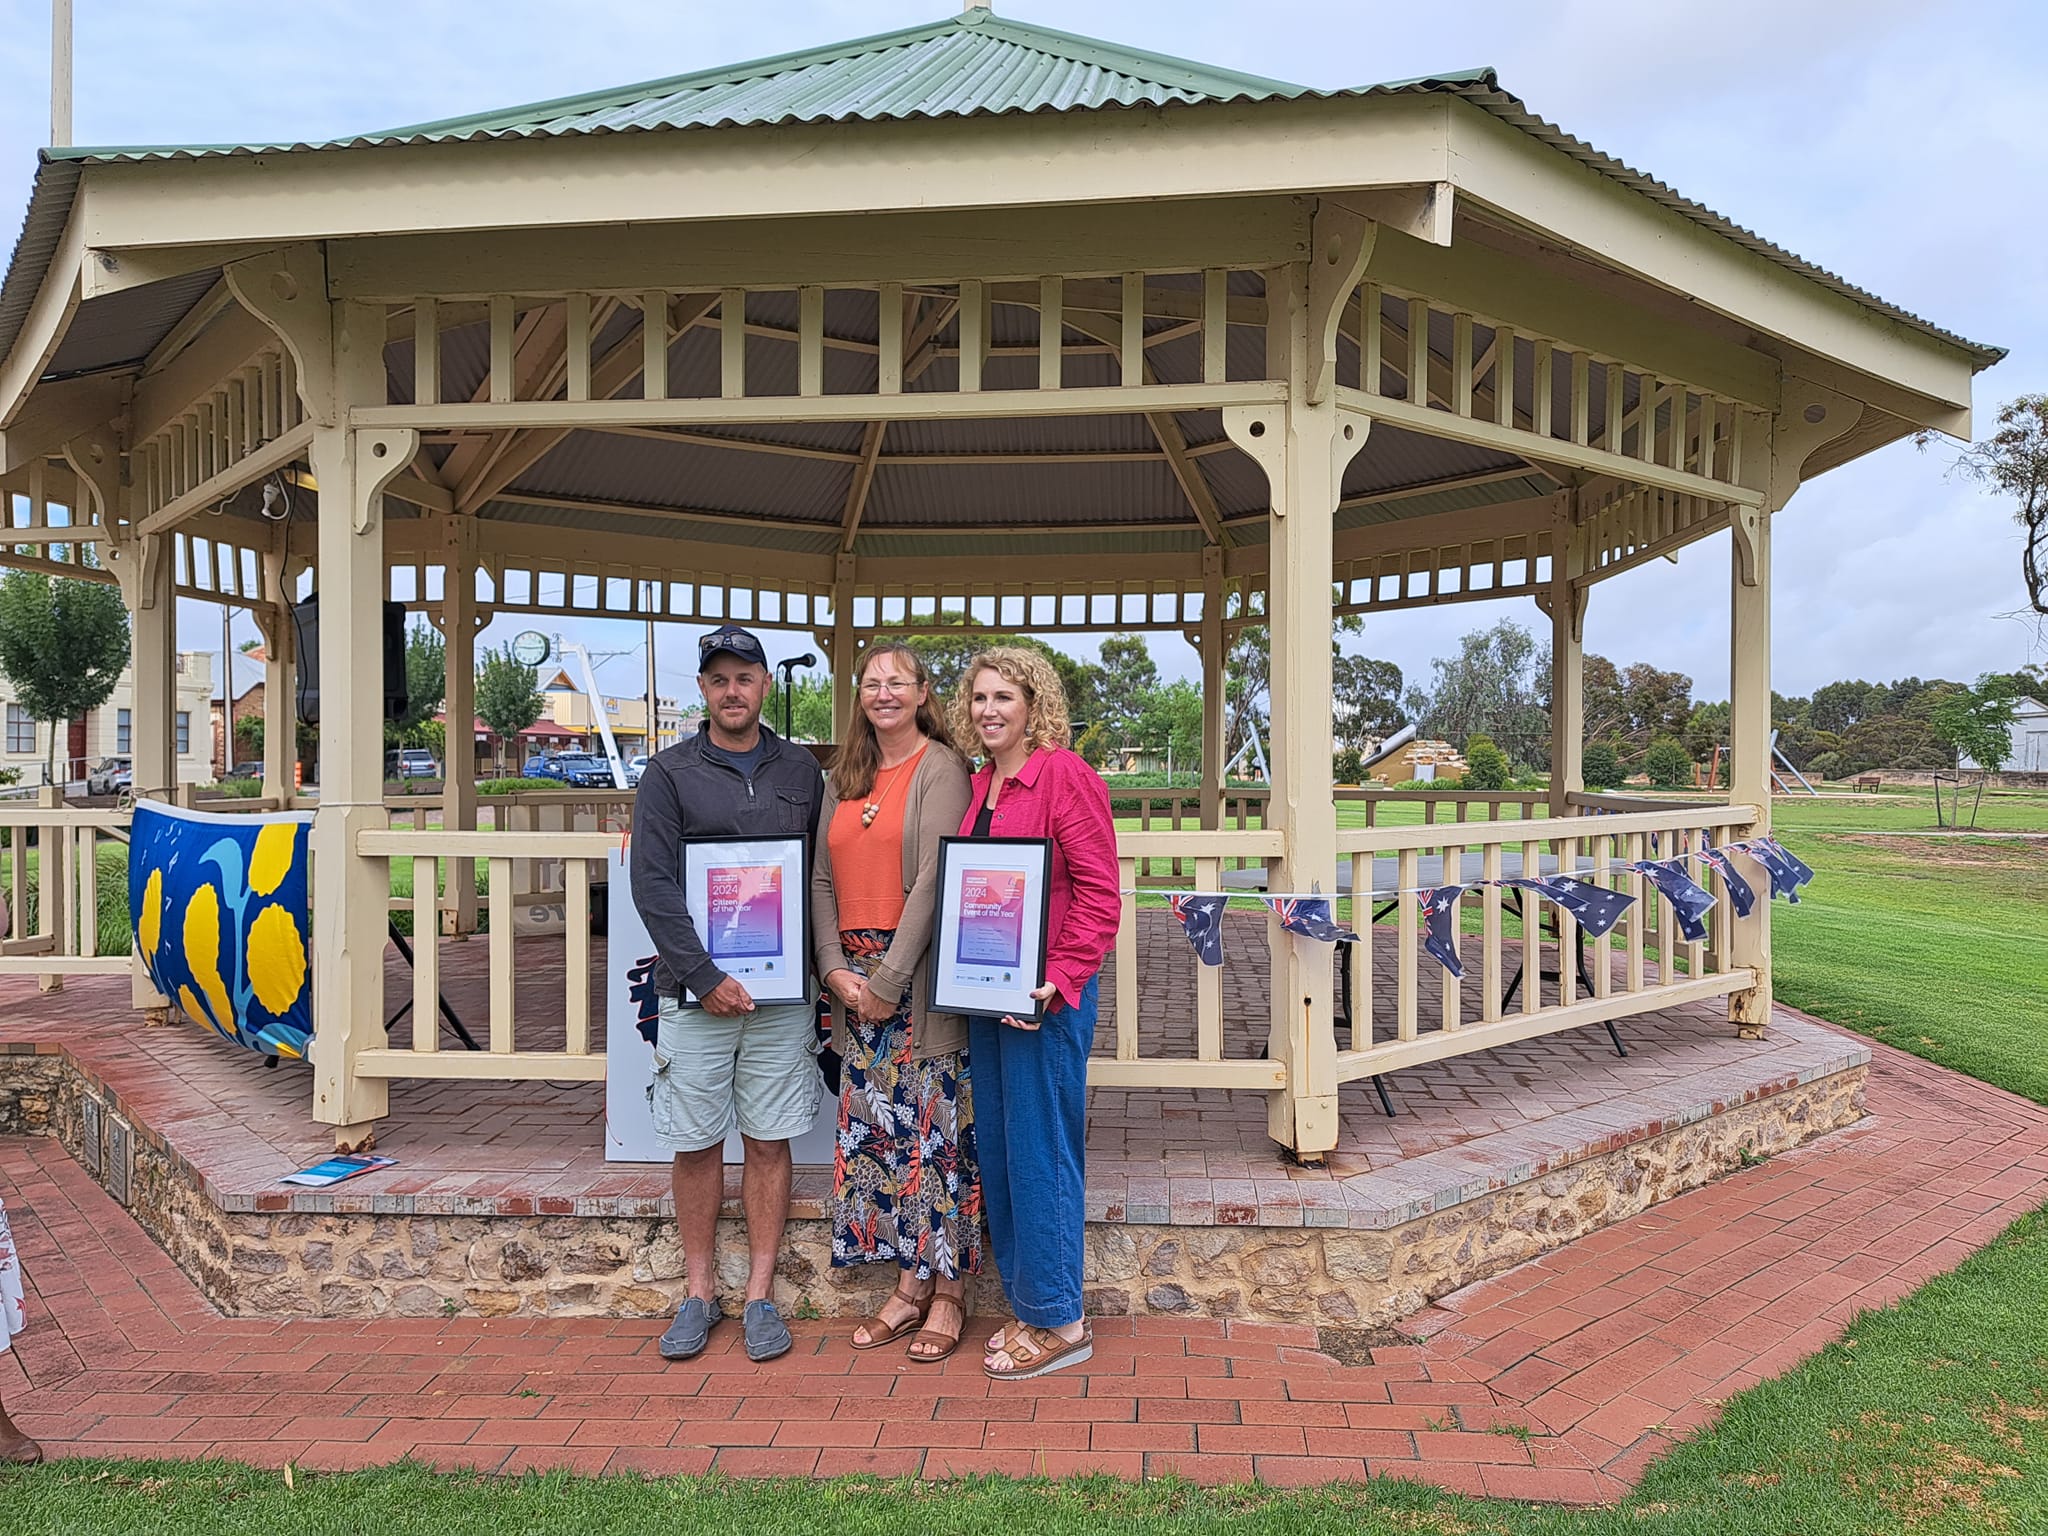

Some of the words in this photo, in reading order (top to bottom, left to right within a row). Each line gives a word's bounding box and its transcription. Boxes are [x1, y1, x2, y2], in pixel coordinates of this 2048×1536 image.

[712, 885, 738, 895] 2024
[965, 887, 986, 897] 2024
[735, 904, 752, 912] Year
[964, 902, 1001, 911] Community
[989, 909, 999, 917] the
[1000, 910, 1016, 918] Year
